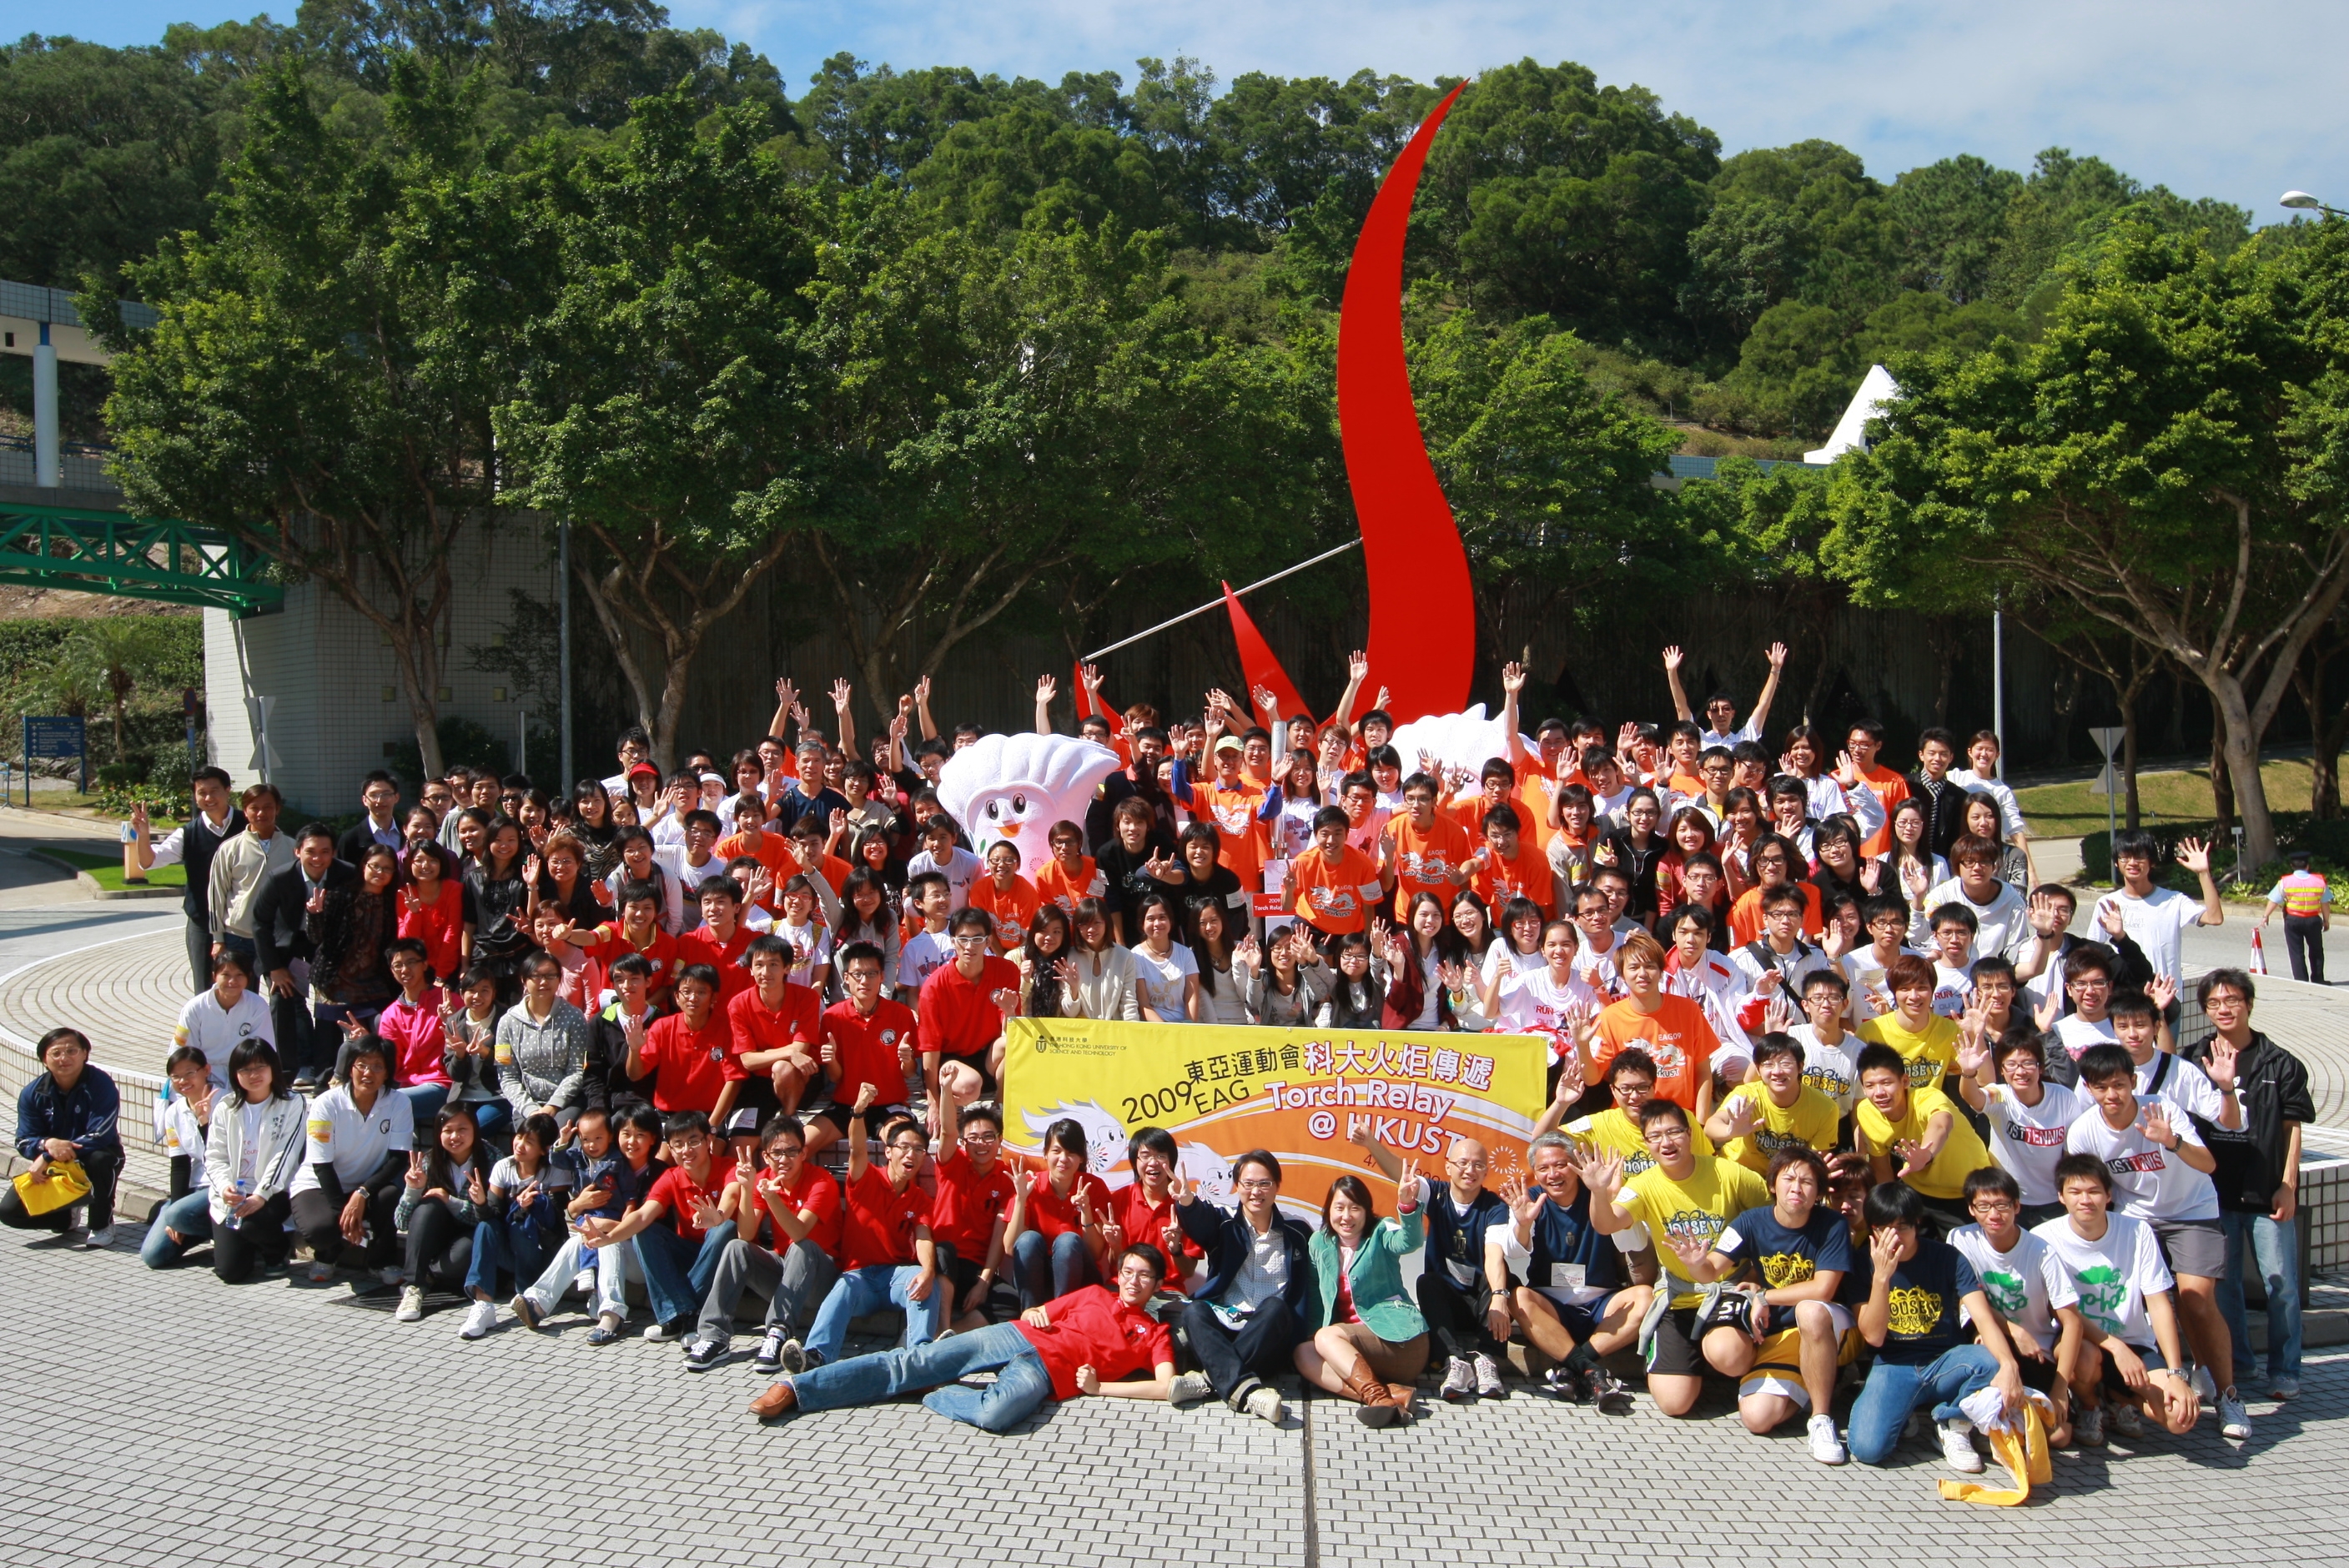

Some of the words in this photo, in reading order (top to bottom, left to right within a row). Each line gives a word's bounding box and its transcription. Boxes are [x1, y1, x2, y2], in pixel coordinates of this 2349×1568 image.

[1536, 1004, 1554, 1015] RUN
[1934, 991, 1953, 1001] RUN
[1658, 1033, 1682, 1041] EAG09
[1184, 1043, 1300, 1085] 東亞運動會
[1303, 1040, 1495, 1091] 科大火炬傳遞
[1802, 1074, 1837, 1092] OUSE
[1121, 1080, 1192, 1124] 2009
[1193, 1079, 1250, 1115] EAG
[1264, 1076, 1356, 1111] Torch
[1366, 1078, 1454, 1124] Relay
[1307, 1109, 1337, 1140] @
[1346, 1111, 1467, 1160] HKUST
